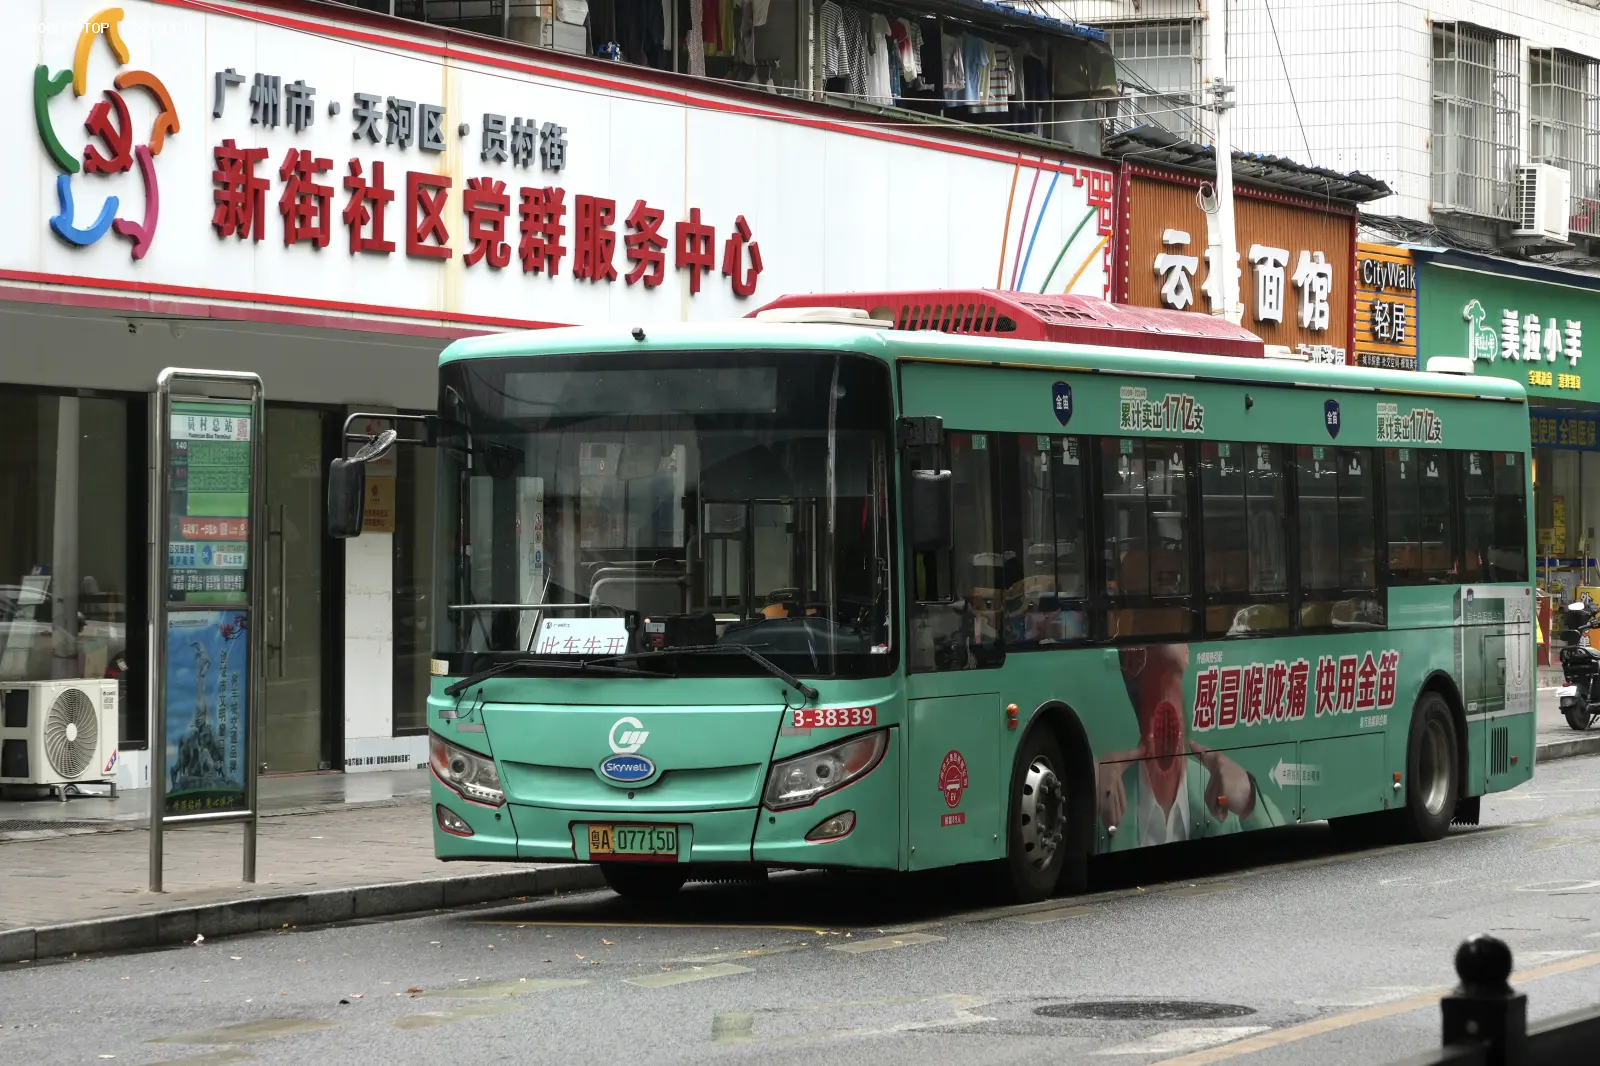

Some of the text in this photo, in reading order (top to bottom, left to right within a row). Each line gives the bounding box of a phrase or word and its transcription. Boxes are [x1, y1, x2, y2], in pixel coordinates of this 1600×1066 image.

[213, 68, 569, 171] 广州市·天河区·员村街
[211, 138, 764, 298] 新街社区党群服务中心
[1154, 228, 1333, 332] 云面馆
[1363, 258, 1416, 292] CityWalk
[1374, 299, 1407, 342] 轻居
[1501, 308, 1583, 367] 美拉小羊
[1120, 395, 1204, 432] 累计卖出17亿支
[1377, 409, 1442, 443] 累计卖出17亿支
[540, 635, 625, 655] 此车先开
[1192, 650, 1399, 732] 感冒喉咙痛 快用金笛
[794, 708, 873, 727] 3-38339
[591, 829, 675, 851] 粤A 07715D
